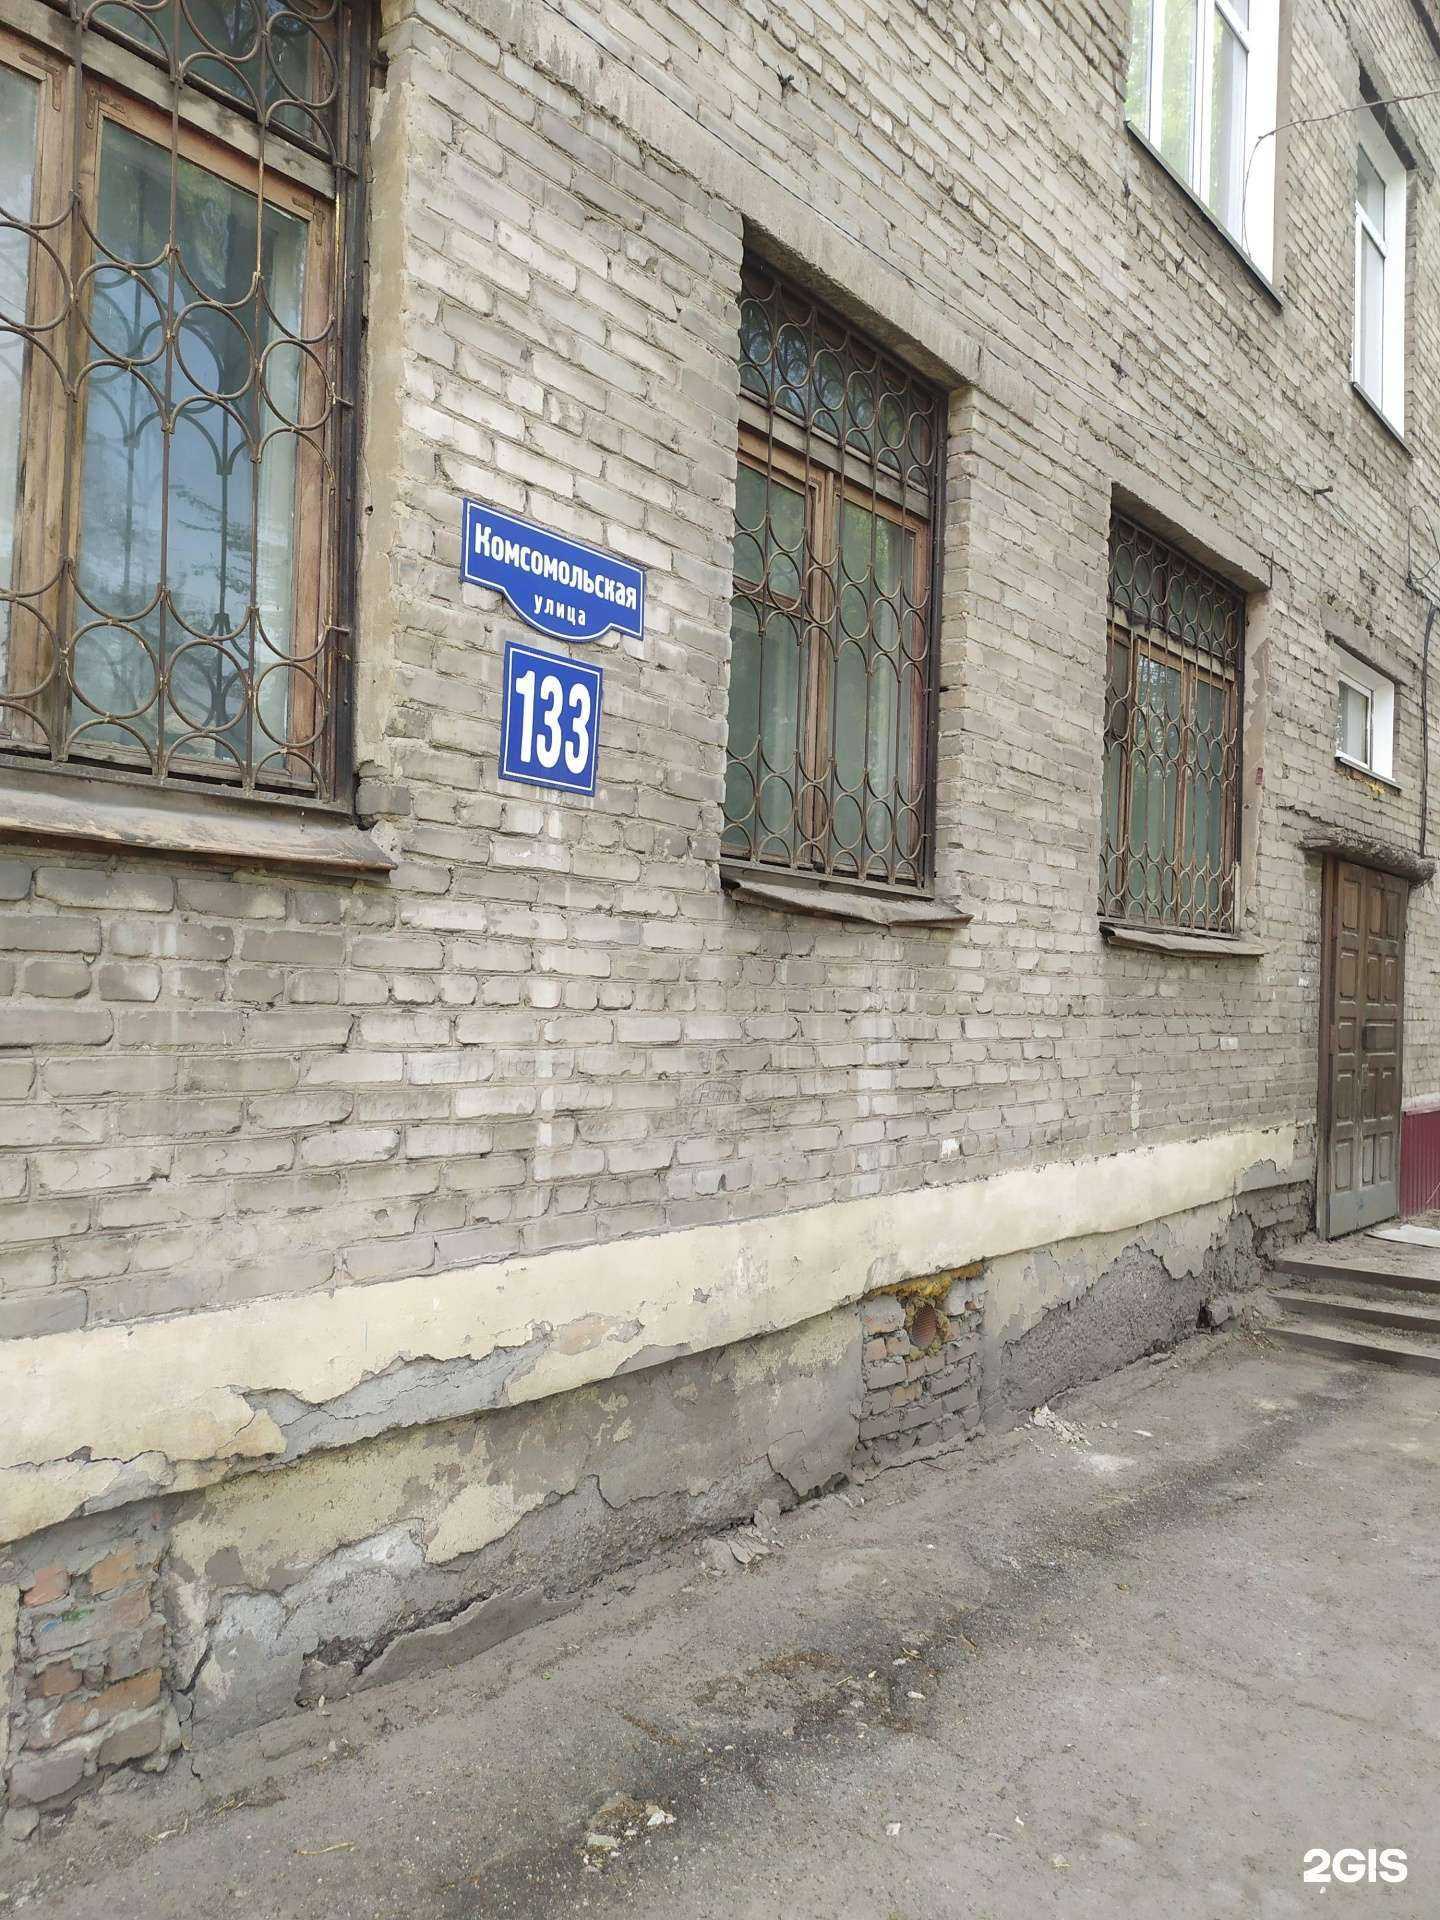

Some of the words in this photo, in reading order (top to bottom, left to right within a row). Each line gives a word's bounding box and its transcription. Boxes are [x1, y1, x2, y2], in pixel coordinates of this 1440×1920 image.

[474, 522, 637, 610] Комсомольская
[533, 594, 586, 626] улица
[515, 670, 591, 774] 133
